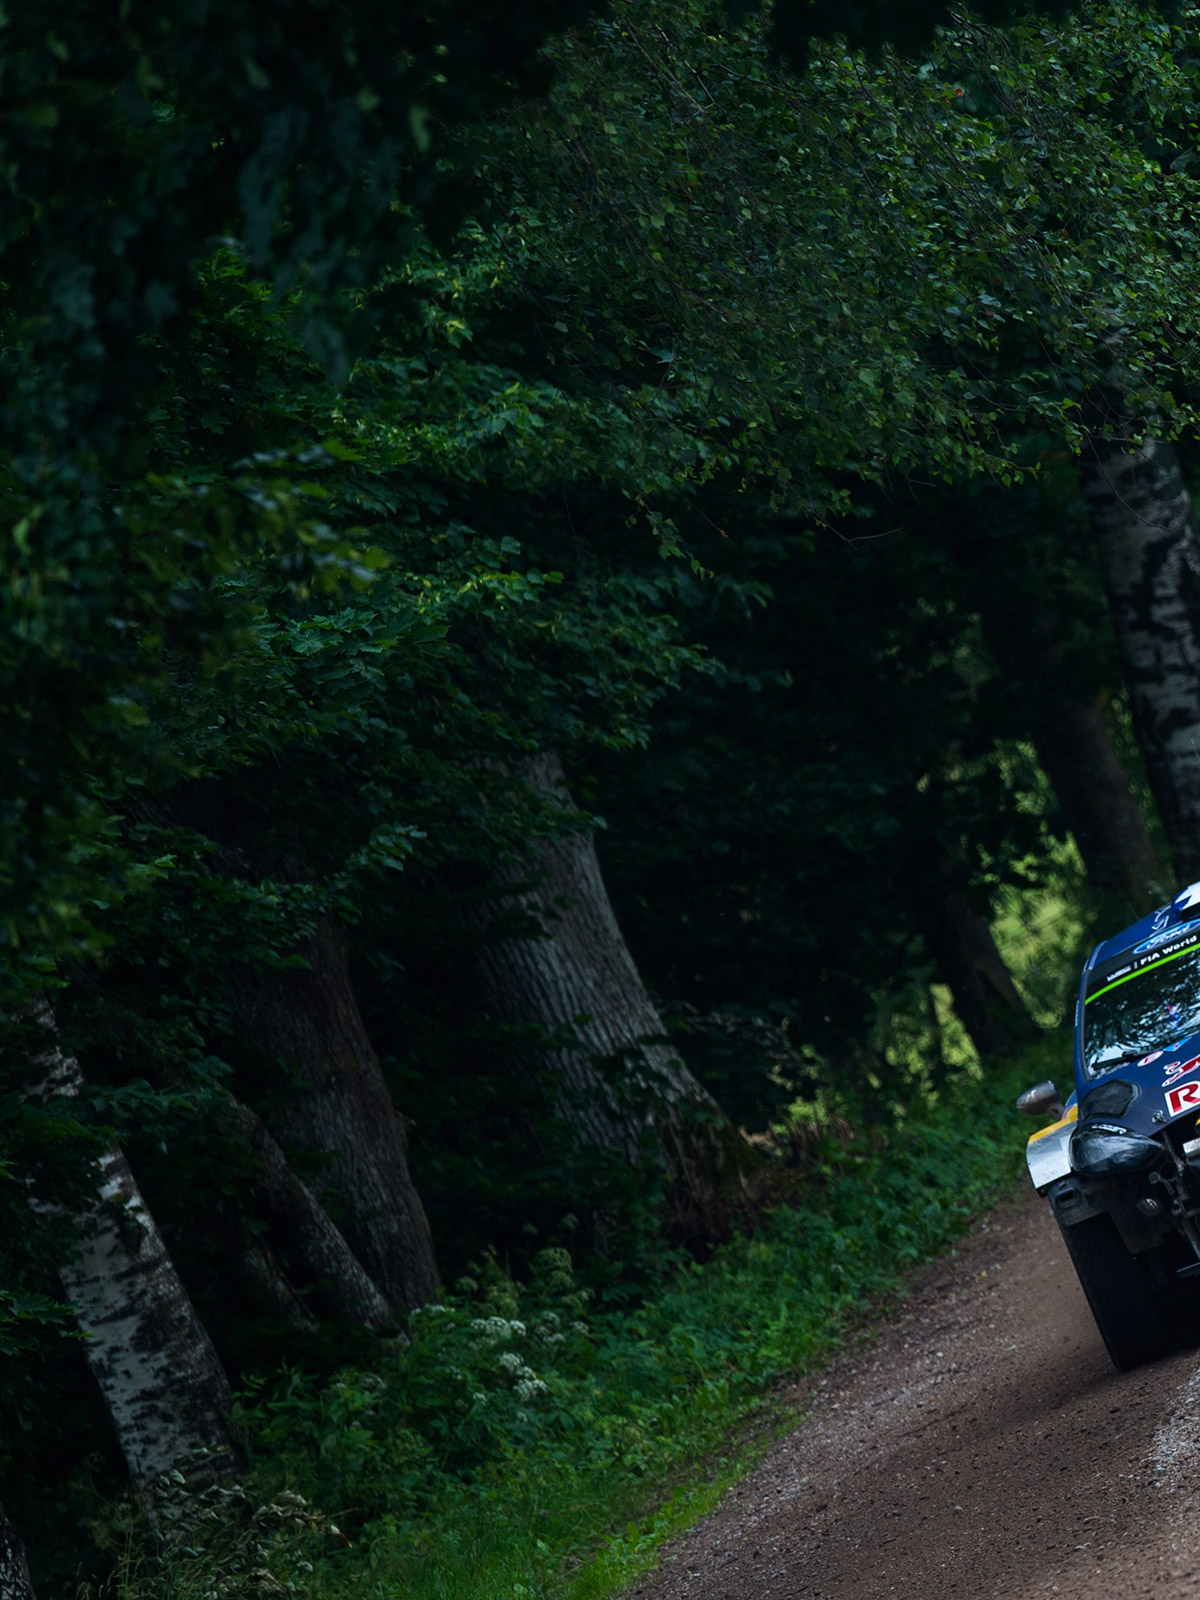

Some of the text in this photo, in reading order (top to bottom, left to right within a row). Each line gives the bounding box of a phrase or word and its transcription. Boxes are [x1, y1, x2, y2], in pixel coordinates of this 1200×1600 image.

[1140, 952, 1160, 966] FIA
[1162, 935, 1198, 955] World
[1142, 922, 1194, 951] Ford
